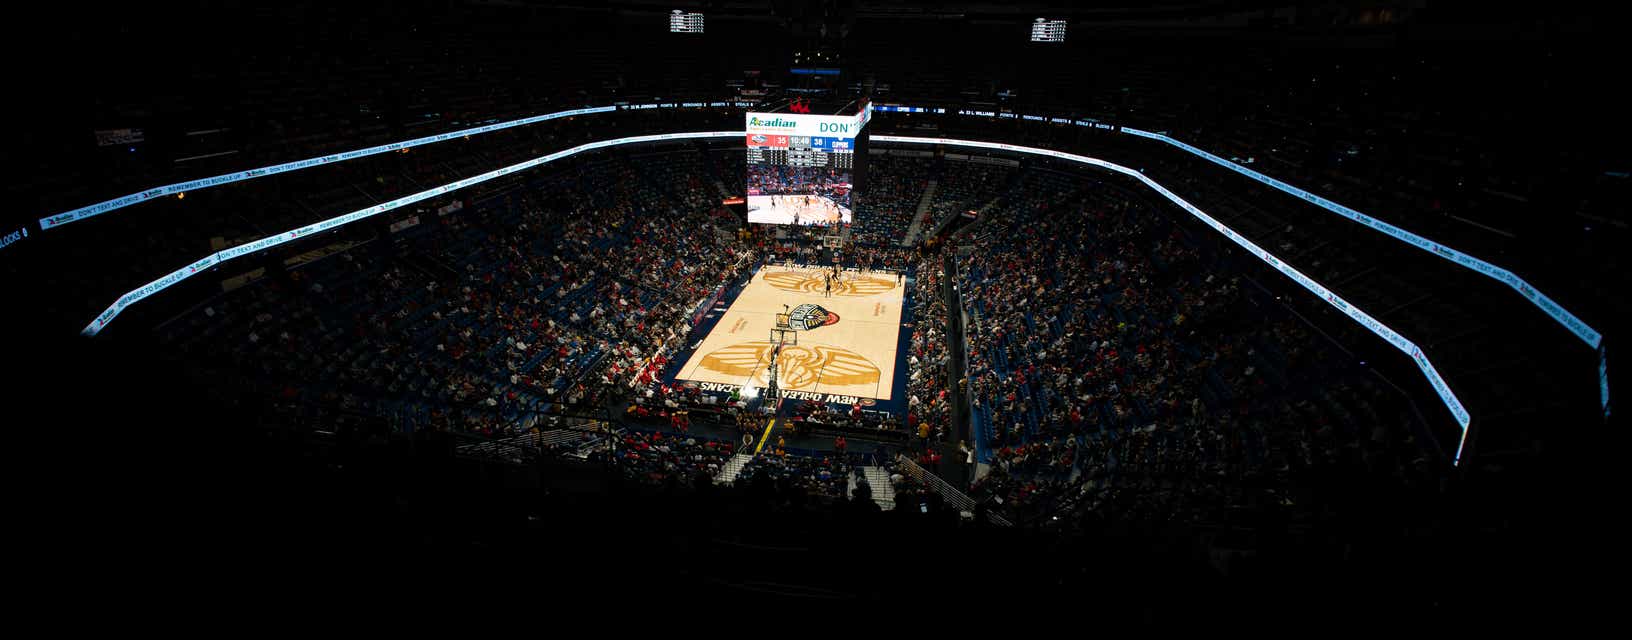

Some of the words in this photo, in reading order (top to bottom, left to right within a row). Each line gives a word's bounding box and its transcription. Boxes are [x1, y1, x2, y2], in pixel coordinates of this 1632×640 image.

[749, 117, 796, 128] Acadian
[144, 285, 154, 293] TO
[764, 389, 822, 402] ORLEA
[826, 394, 858, 404] NEW
